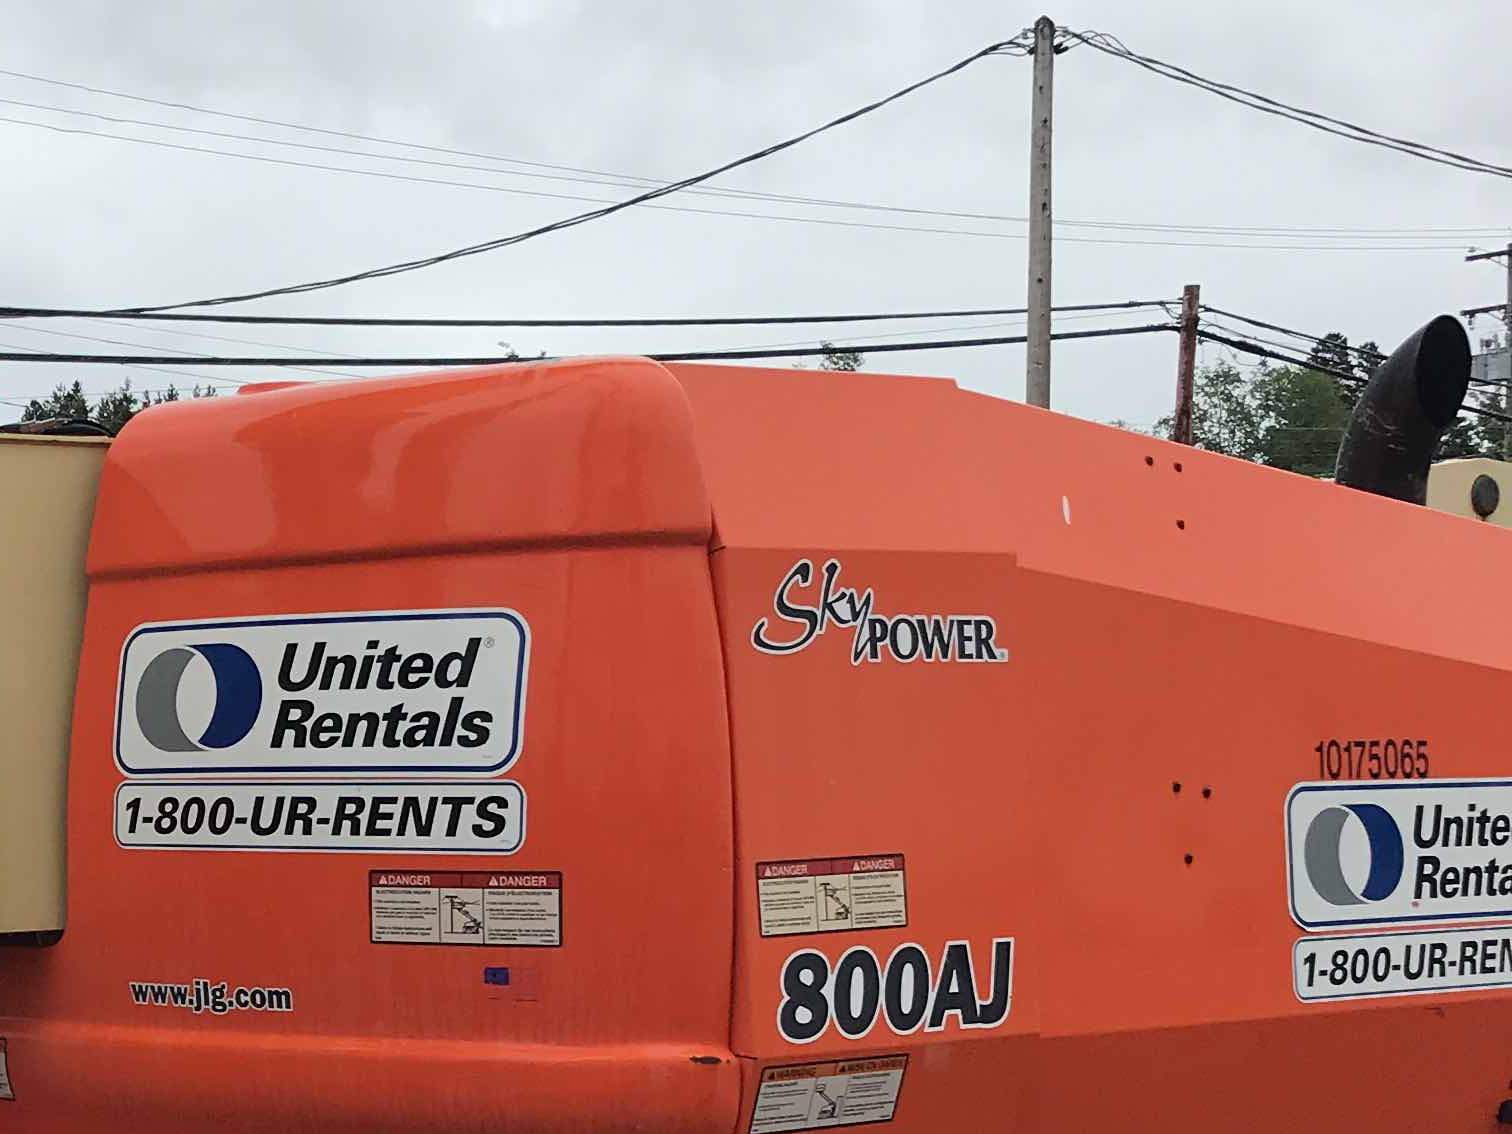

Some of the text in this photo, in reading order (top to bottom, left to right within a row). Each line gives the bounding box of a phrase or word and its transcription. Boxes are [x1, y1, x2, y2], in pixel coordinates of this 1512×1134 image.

[753, 561, 999, 663] Sky POWER
[277, 637, 482, 692] United
[270, 696, 493, 750] Rentals
[1314, 739, 1430, 780] 10175065
[124, 794, 509, 839] 1-800-UR-RENTS
[387, 874, 432, 887] DANGER
[498, 875, 548, 888] DANGER
[770, 864, 808, 876] DANGER
[859, 859, 896, 871] DANGER
[130, 979, 292, 1014] www.jlg.com
[778, 938, 1014, 1042] 800AJ
